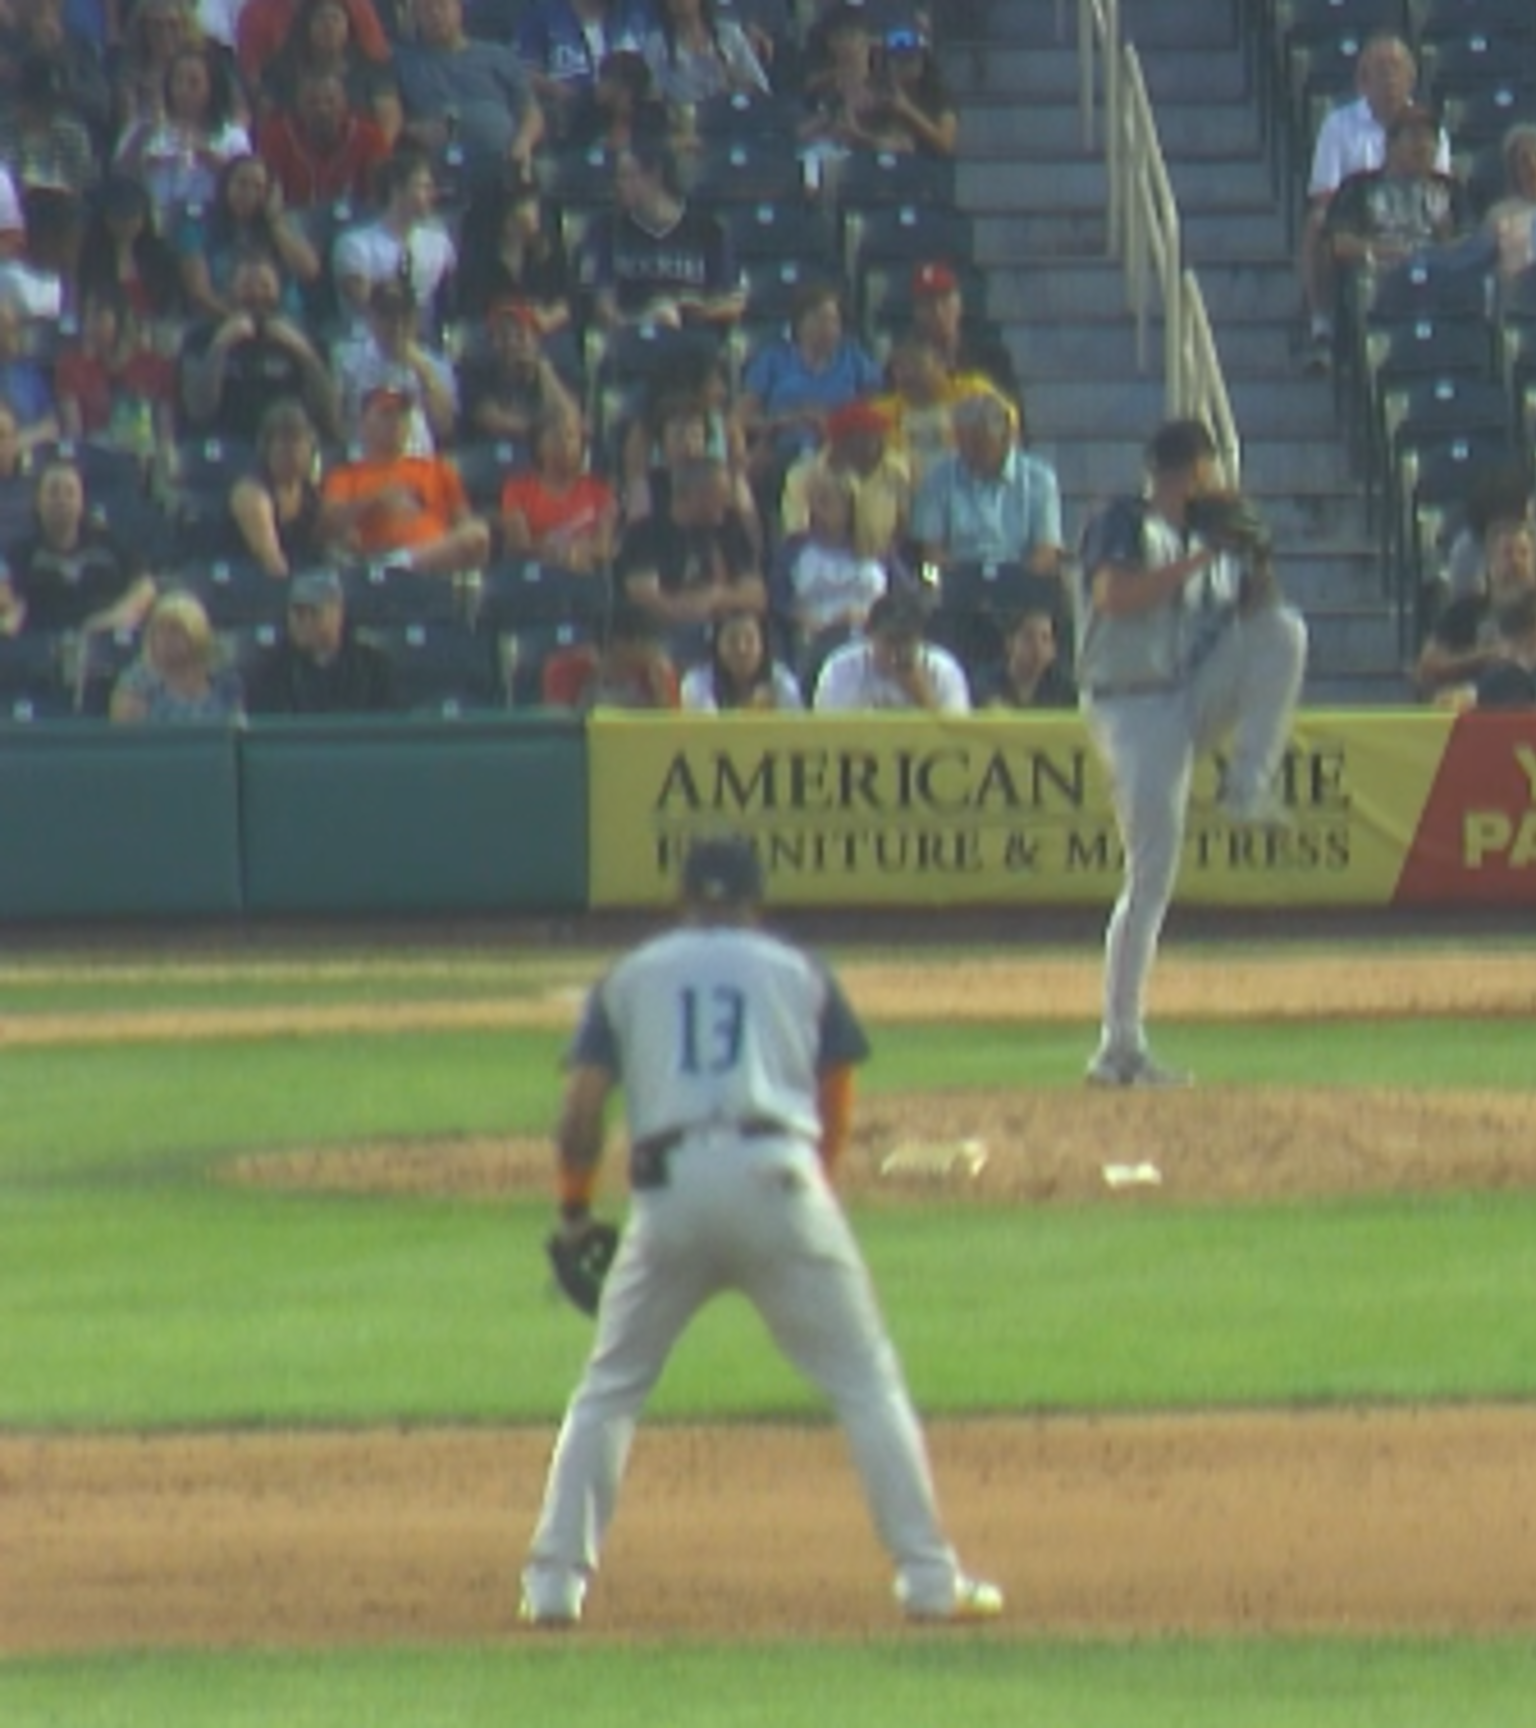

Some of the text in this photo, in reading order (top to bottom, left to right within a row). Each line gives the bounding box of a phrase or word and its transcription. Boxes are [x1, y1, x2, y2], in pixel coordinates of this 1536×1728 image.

[655, 748, 1084, 807] AMERICAN
[656, 830, 986, 875] FNITURE
[1005, 832, 1035, 875] &
[682, 985, 744, 1075] 13
